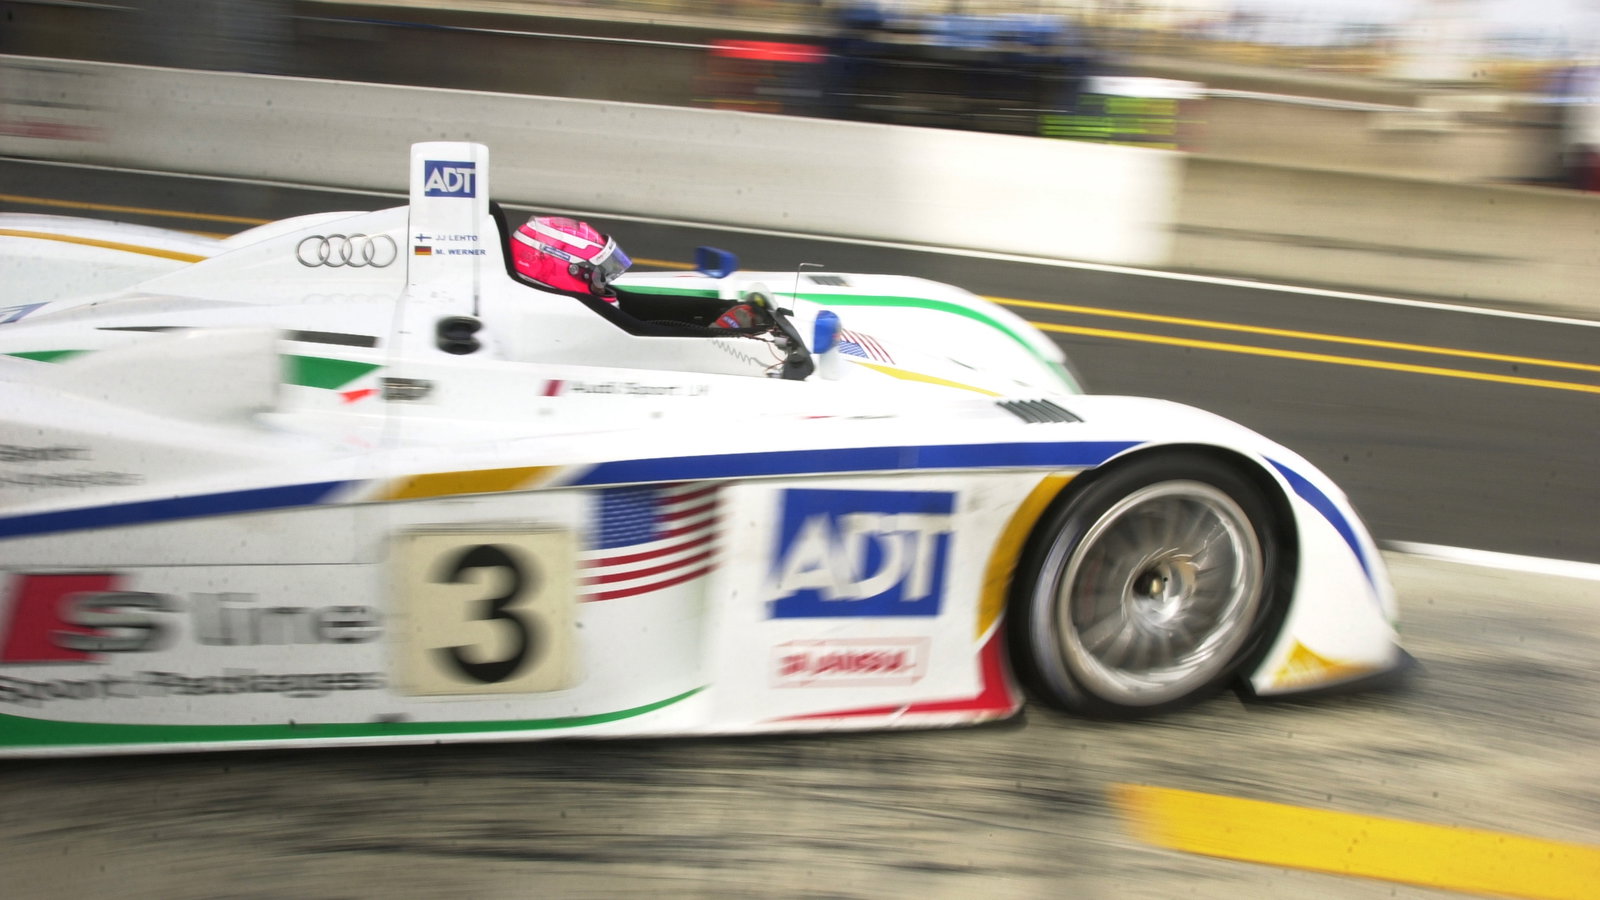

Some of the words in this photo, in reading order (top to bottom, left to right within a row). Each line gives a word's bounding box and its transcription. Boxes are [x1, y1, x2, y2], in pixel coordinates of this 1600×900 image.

[424, 166, 476, 194] ADT
[435, 234, 446, 242] JJ
[448, 234, 479, 242] LEHTO
[435, 248, 446, 256] M.
[448, 248, 487, 256] WERNER
[764, 511, 958, 602] ADT
[427, 543, 545, 685] 3
